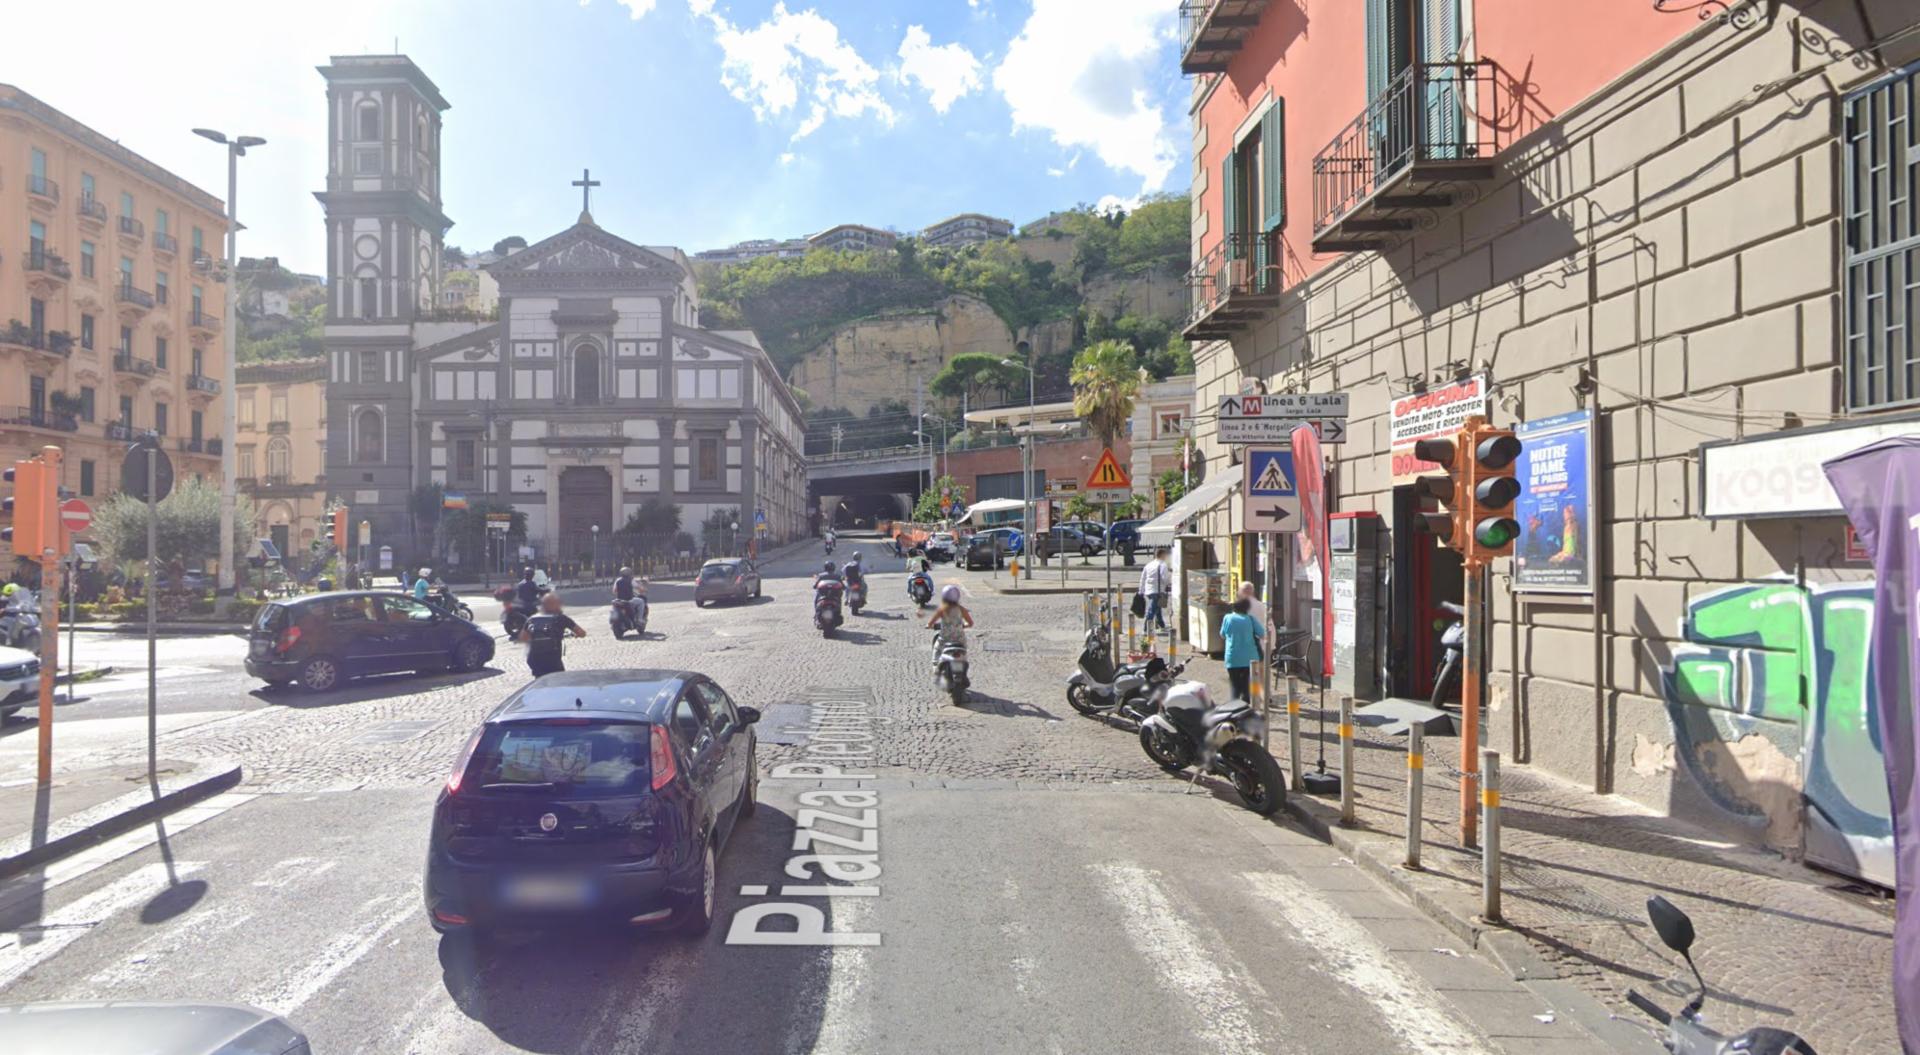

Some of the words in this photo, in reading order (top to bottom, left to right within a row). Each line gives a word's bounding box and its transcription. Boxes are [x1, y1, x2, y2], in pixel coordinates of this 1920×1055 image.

[1263, 396, 1294, 407] linea
[1299, 396, 1307, 406] 6
[1394, 379, 1479, 417] OFFICINA
[1392, 414, 1420, 429] VENDITA
[1446, 400, 1483, 415] SCOOTER
[1221, 423, 1239, 431] linea
[1241, 423, 1246, 431] 2
[1254, 423, 1260, 431] 6
[1396, 422, 1435, 438] ACCESSORI
[1436, 420, 1441, 429] E
[1530, 443, 1568, 463] NOTRE
[1531, 458, 1566, 476] DAME
[1530, 475, 1540, 486] DE
[1541, 472, 1568, 485] PARIS
[1097, 492, 1109, 500] 50
